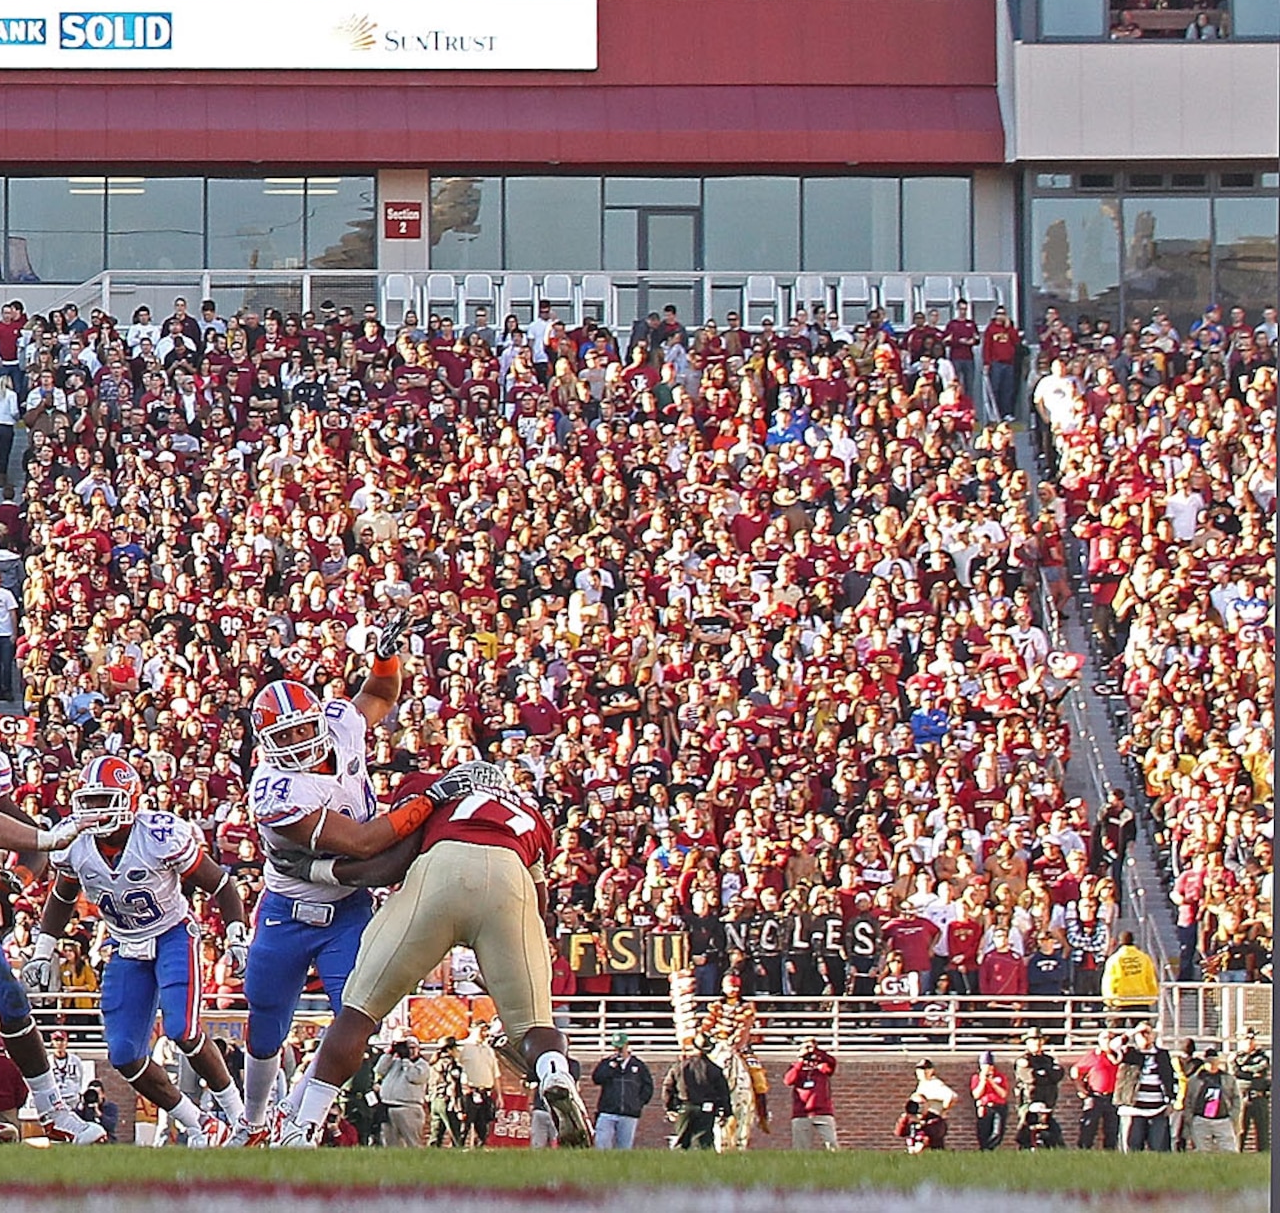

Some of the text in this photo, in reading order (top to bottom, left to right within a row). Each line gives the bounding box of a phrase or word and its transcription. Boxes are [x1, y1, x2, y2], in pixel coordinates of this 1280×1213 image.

[61, 14, 170, 47] SOLID
[386, 207, 420, 220] Section
[399, 221, 408, 234] 2
[254, 775, 293, 803] 94
[95, 887, 166, 930] 43
